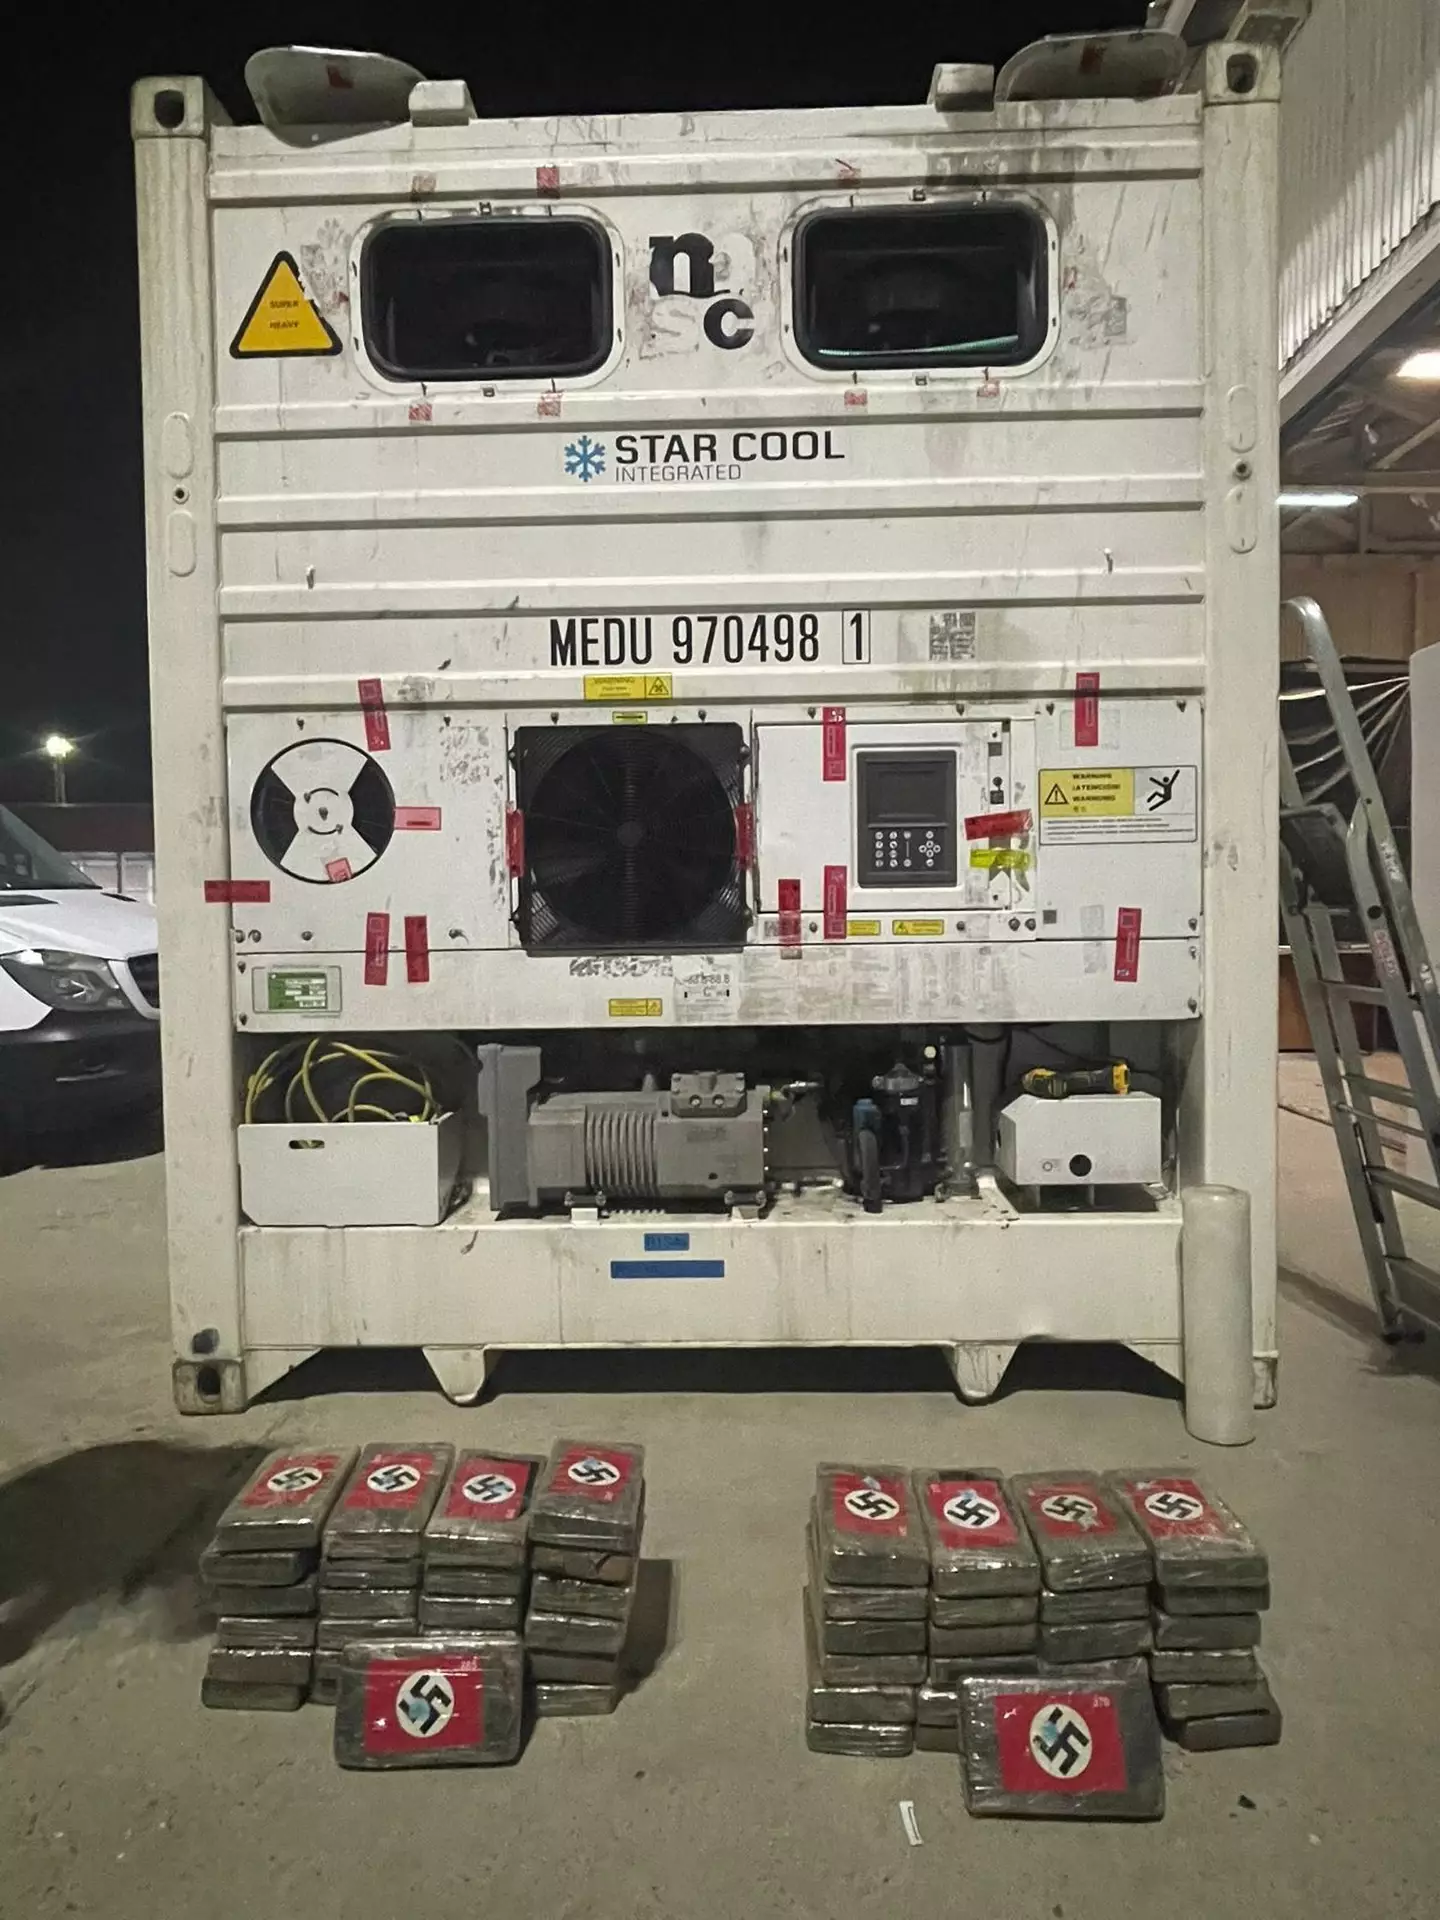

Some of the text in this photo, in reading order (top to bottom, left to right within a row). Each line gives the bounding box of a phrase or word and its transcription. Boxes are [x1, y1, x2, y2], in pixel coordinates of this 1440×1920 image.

[268, 300, 300, 309] SUPER
[268, 320, 300, 330] HEAVY
[615, 430, 846, 464] STAR COOL
[615, 463, 742, 483] INTEGRATED
[550, 616, 652, 666] MEDU
[671, 613, 820, 665] 970498
